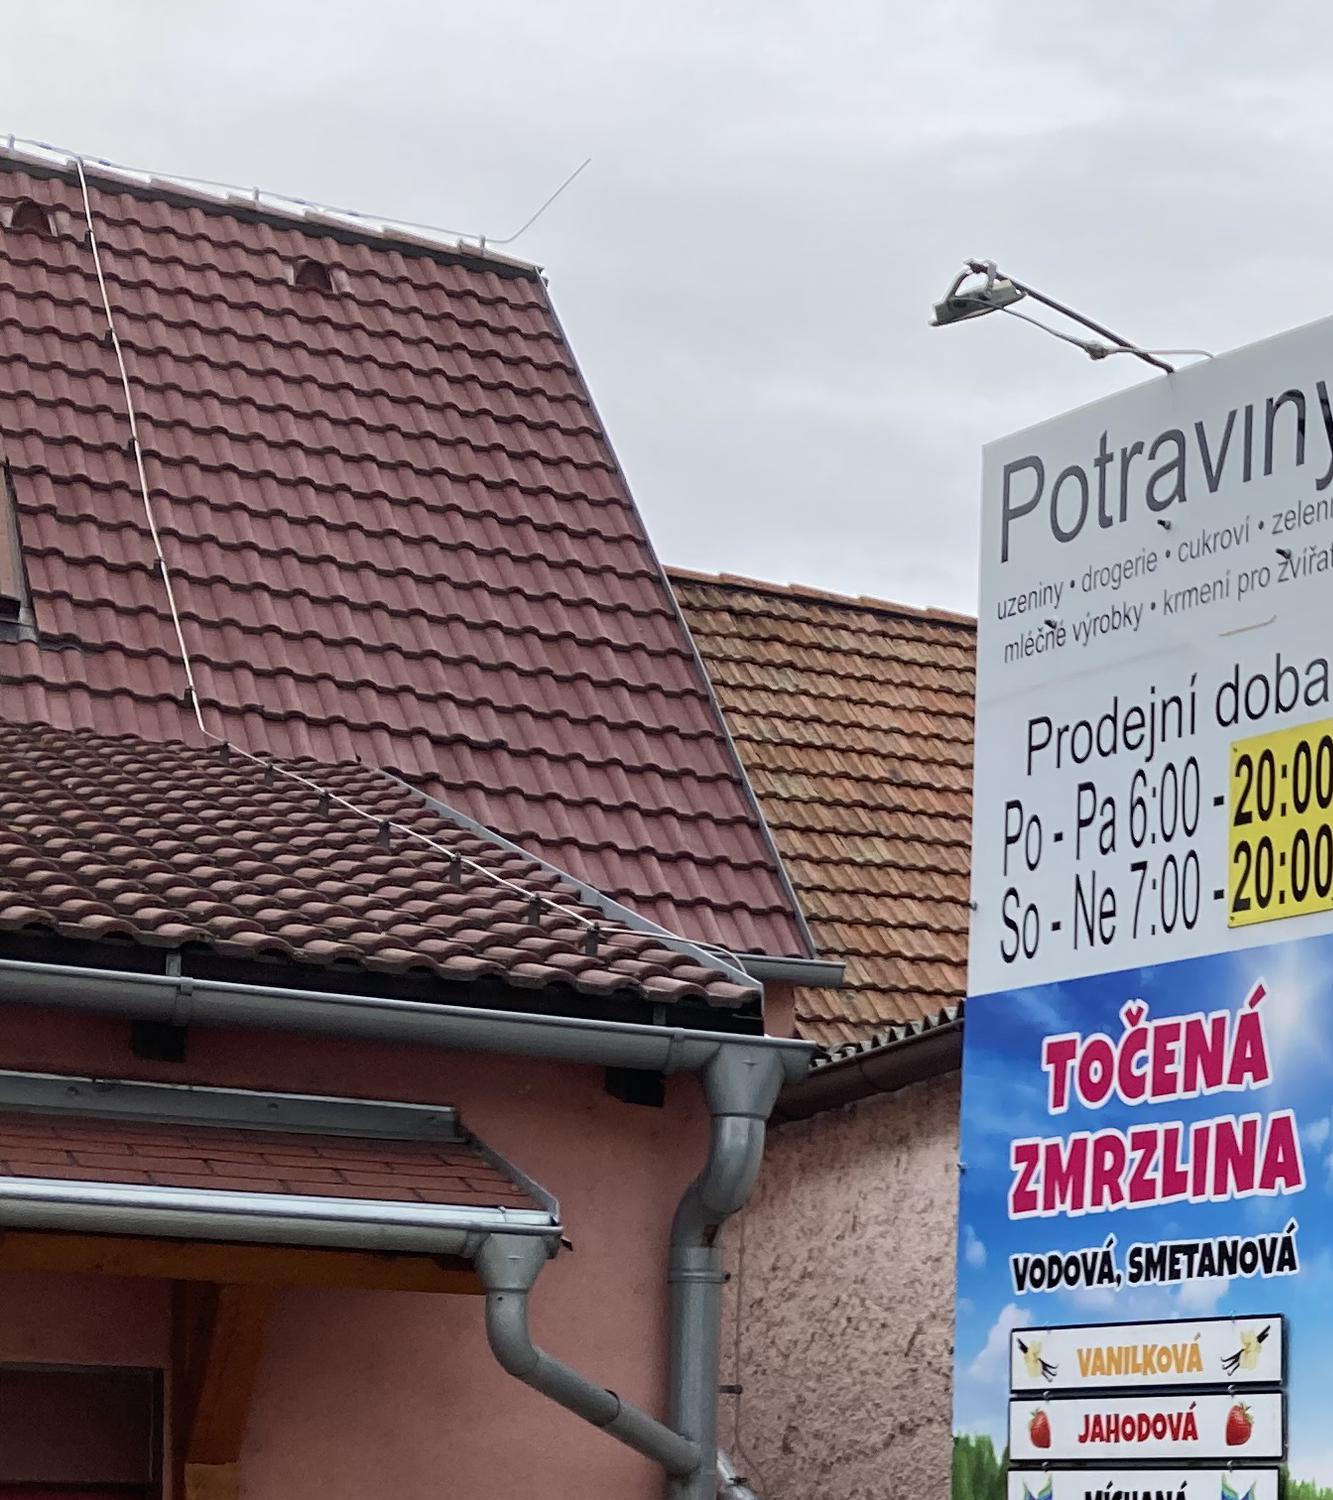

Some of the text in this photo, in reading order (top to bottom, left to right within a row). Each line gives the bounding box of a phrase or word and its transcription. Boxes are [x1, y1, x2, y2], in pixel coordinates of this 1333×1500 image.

[997, 581, 1063, 620] uzeniny
[1081, 547, 1158, 592] drogerie
[1177, 515, 1250, 562] cukroví
[1004, 623, 1067, 664] mléčné
[1072, 601, 1143, 647] výrobky
[1162, 569, 1231, 617] krmení
[1238, 566, 1271, 601] pro
[1027, 653, 1329, 776] Prodejní doba
[1003, 799, 1042, 877] Po
[1076, 781, 1116, 860] Pa
[1130, 756, 1200, 848] 6:00
[1000, 887, 1040, 964] So
[1074, 870, 1116, 950] Ne
[1130, 849, 1200, 939] 7:00
[1231, 823, 1333, 913] 20:00
[1045, 983, 1270, 1109] TOČENÁ
[1012, 1114, 1306, 1213] ZMRZLINA
[1013, 1223, 1299, 1292] VODOVÁ, SMETANOVÁ
[1076, 1333, 1204, 1378] VANILKOVÁ
[1077, 1402, 1200, 1444] JAHODOVÁ
